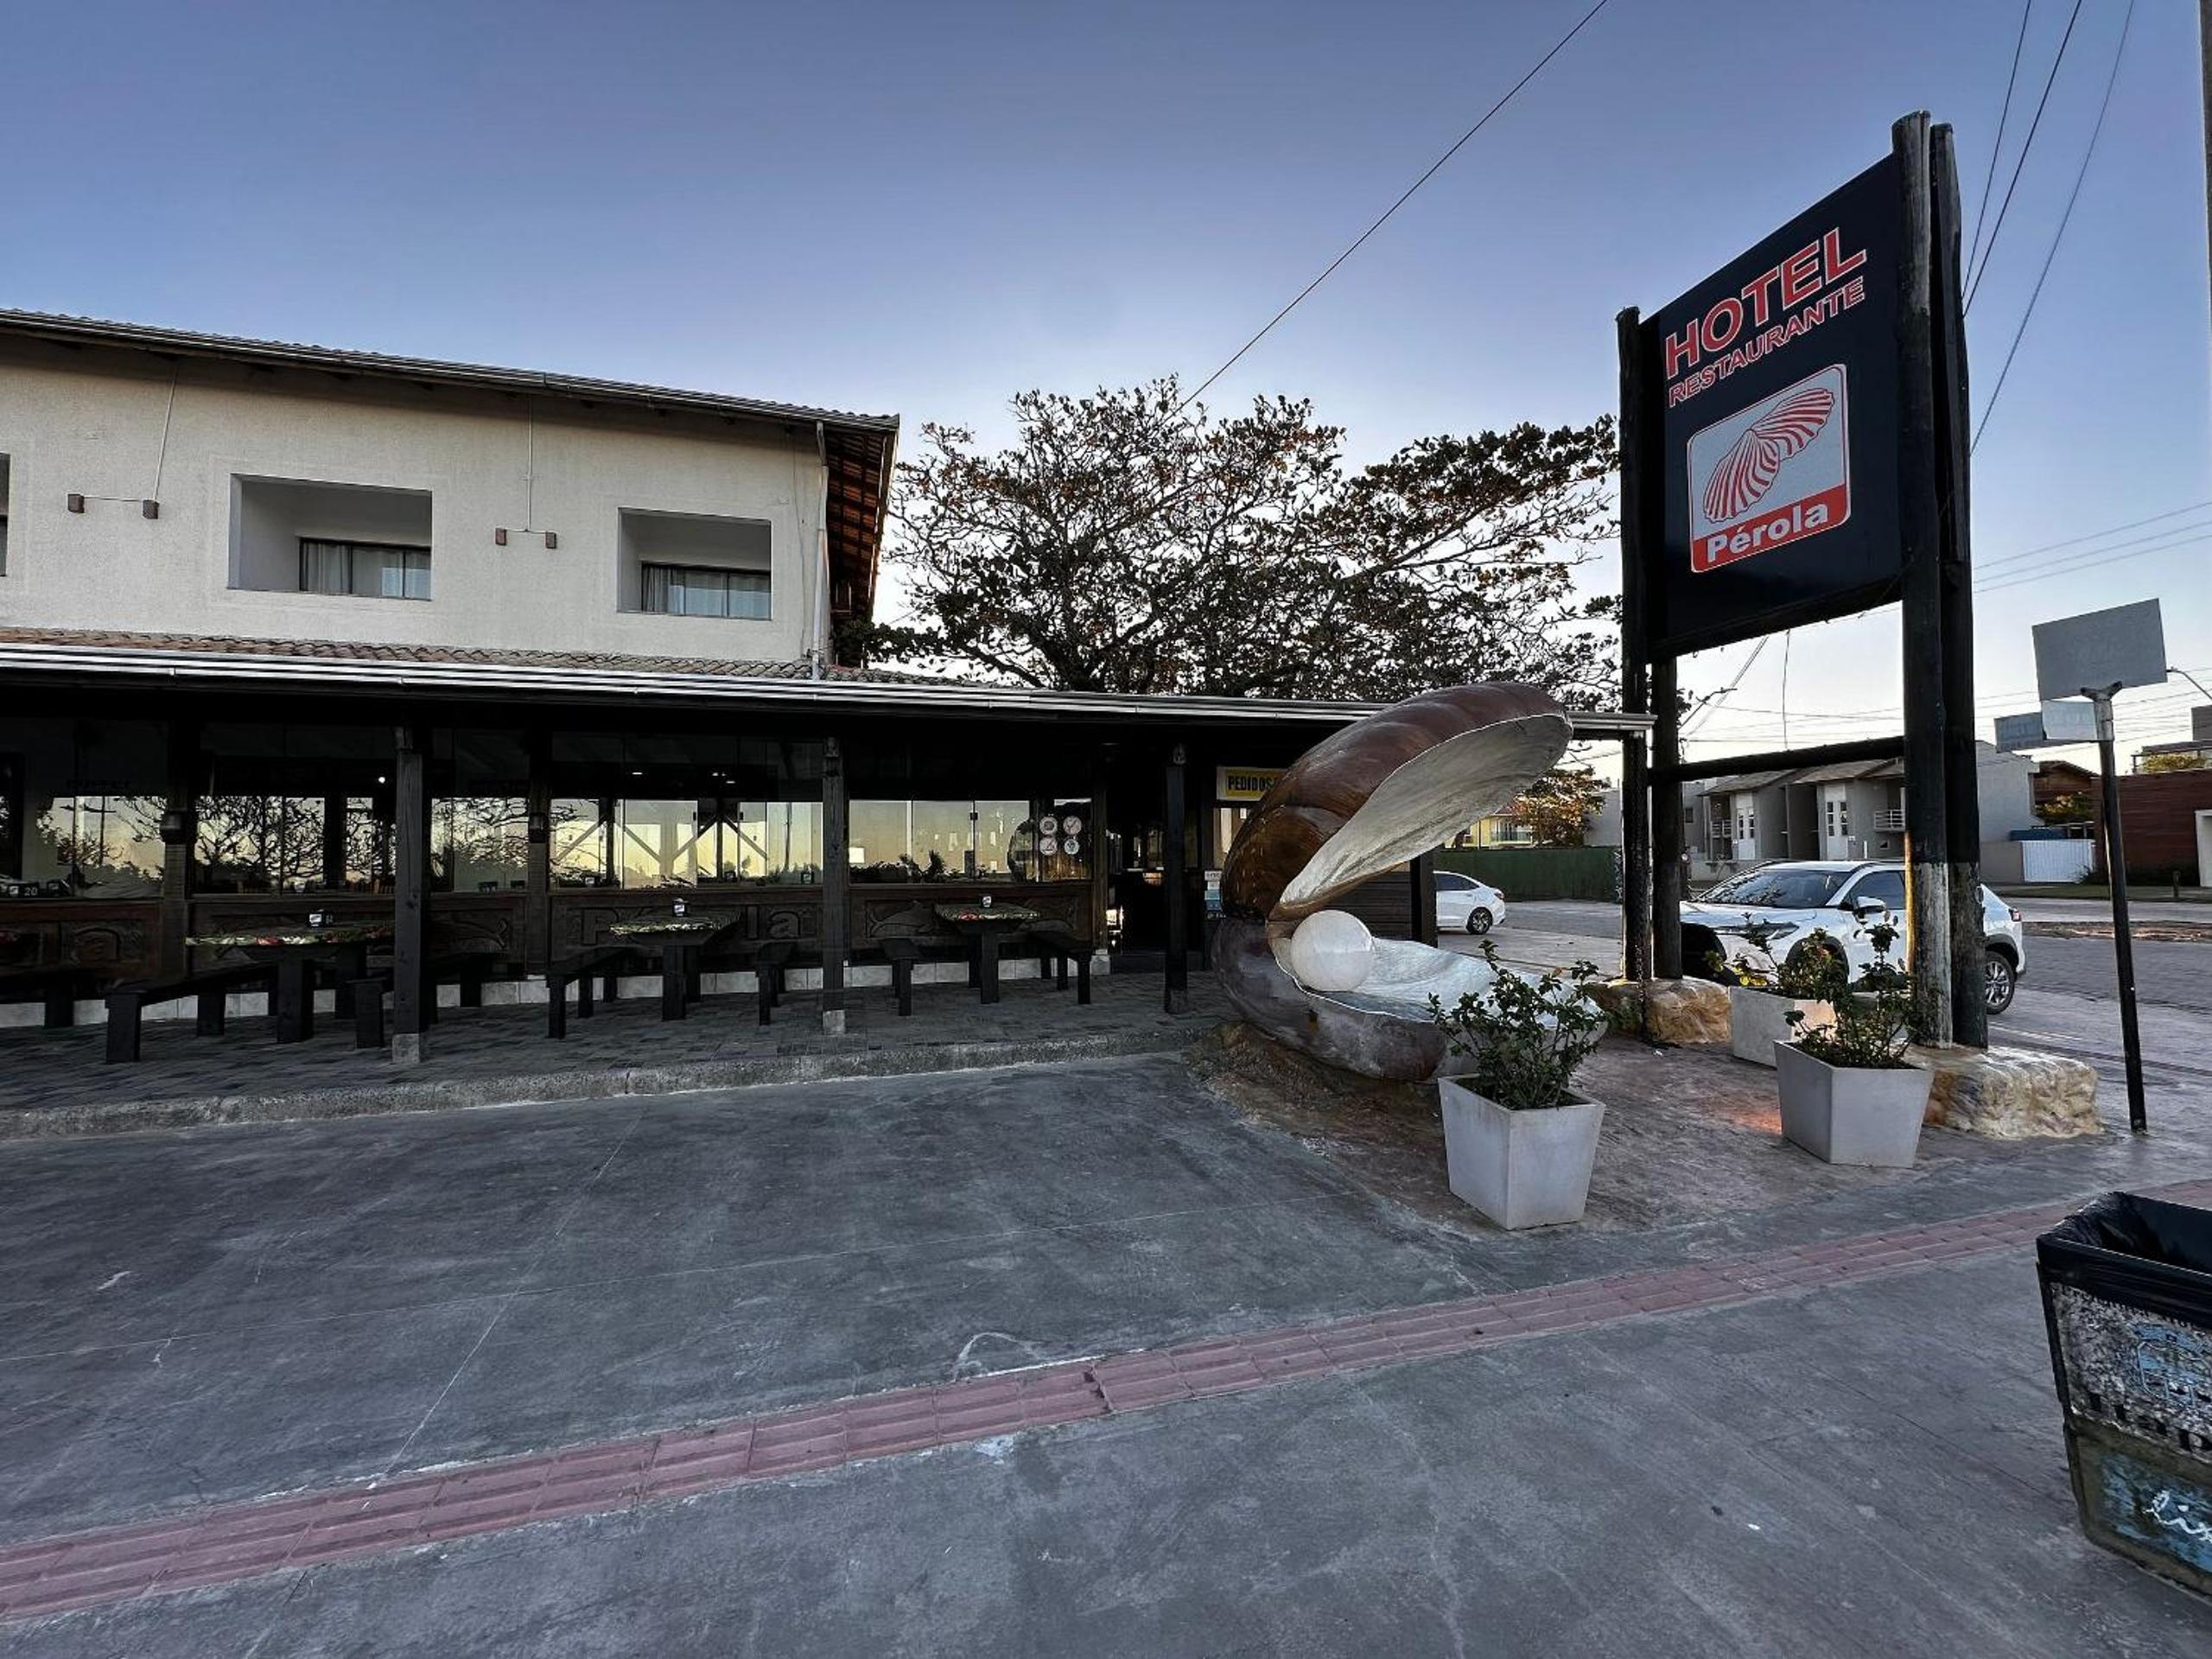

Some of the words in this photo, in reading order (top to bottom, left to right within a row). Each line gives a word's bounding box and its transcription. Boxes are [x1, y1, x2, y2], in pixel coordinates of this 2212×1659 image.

[1665, 227, 1866, 379] HOTEL
[1669, 276, 1866, 408] RESTAURANTE
[1707, 502, 1827, 563] Pérola
